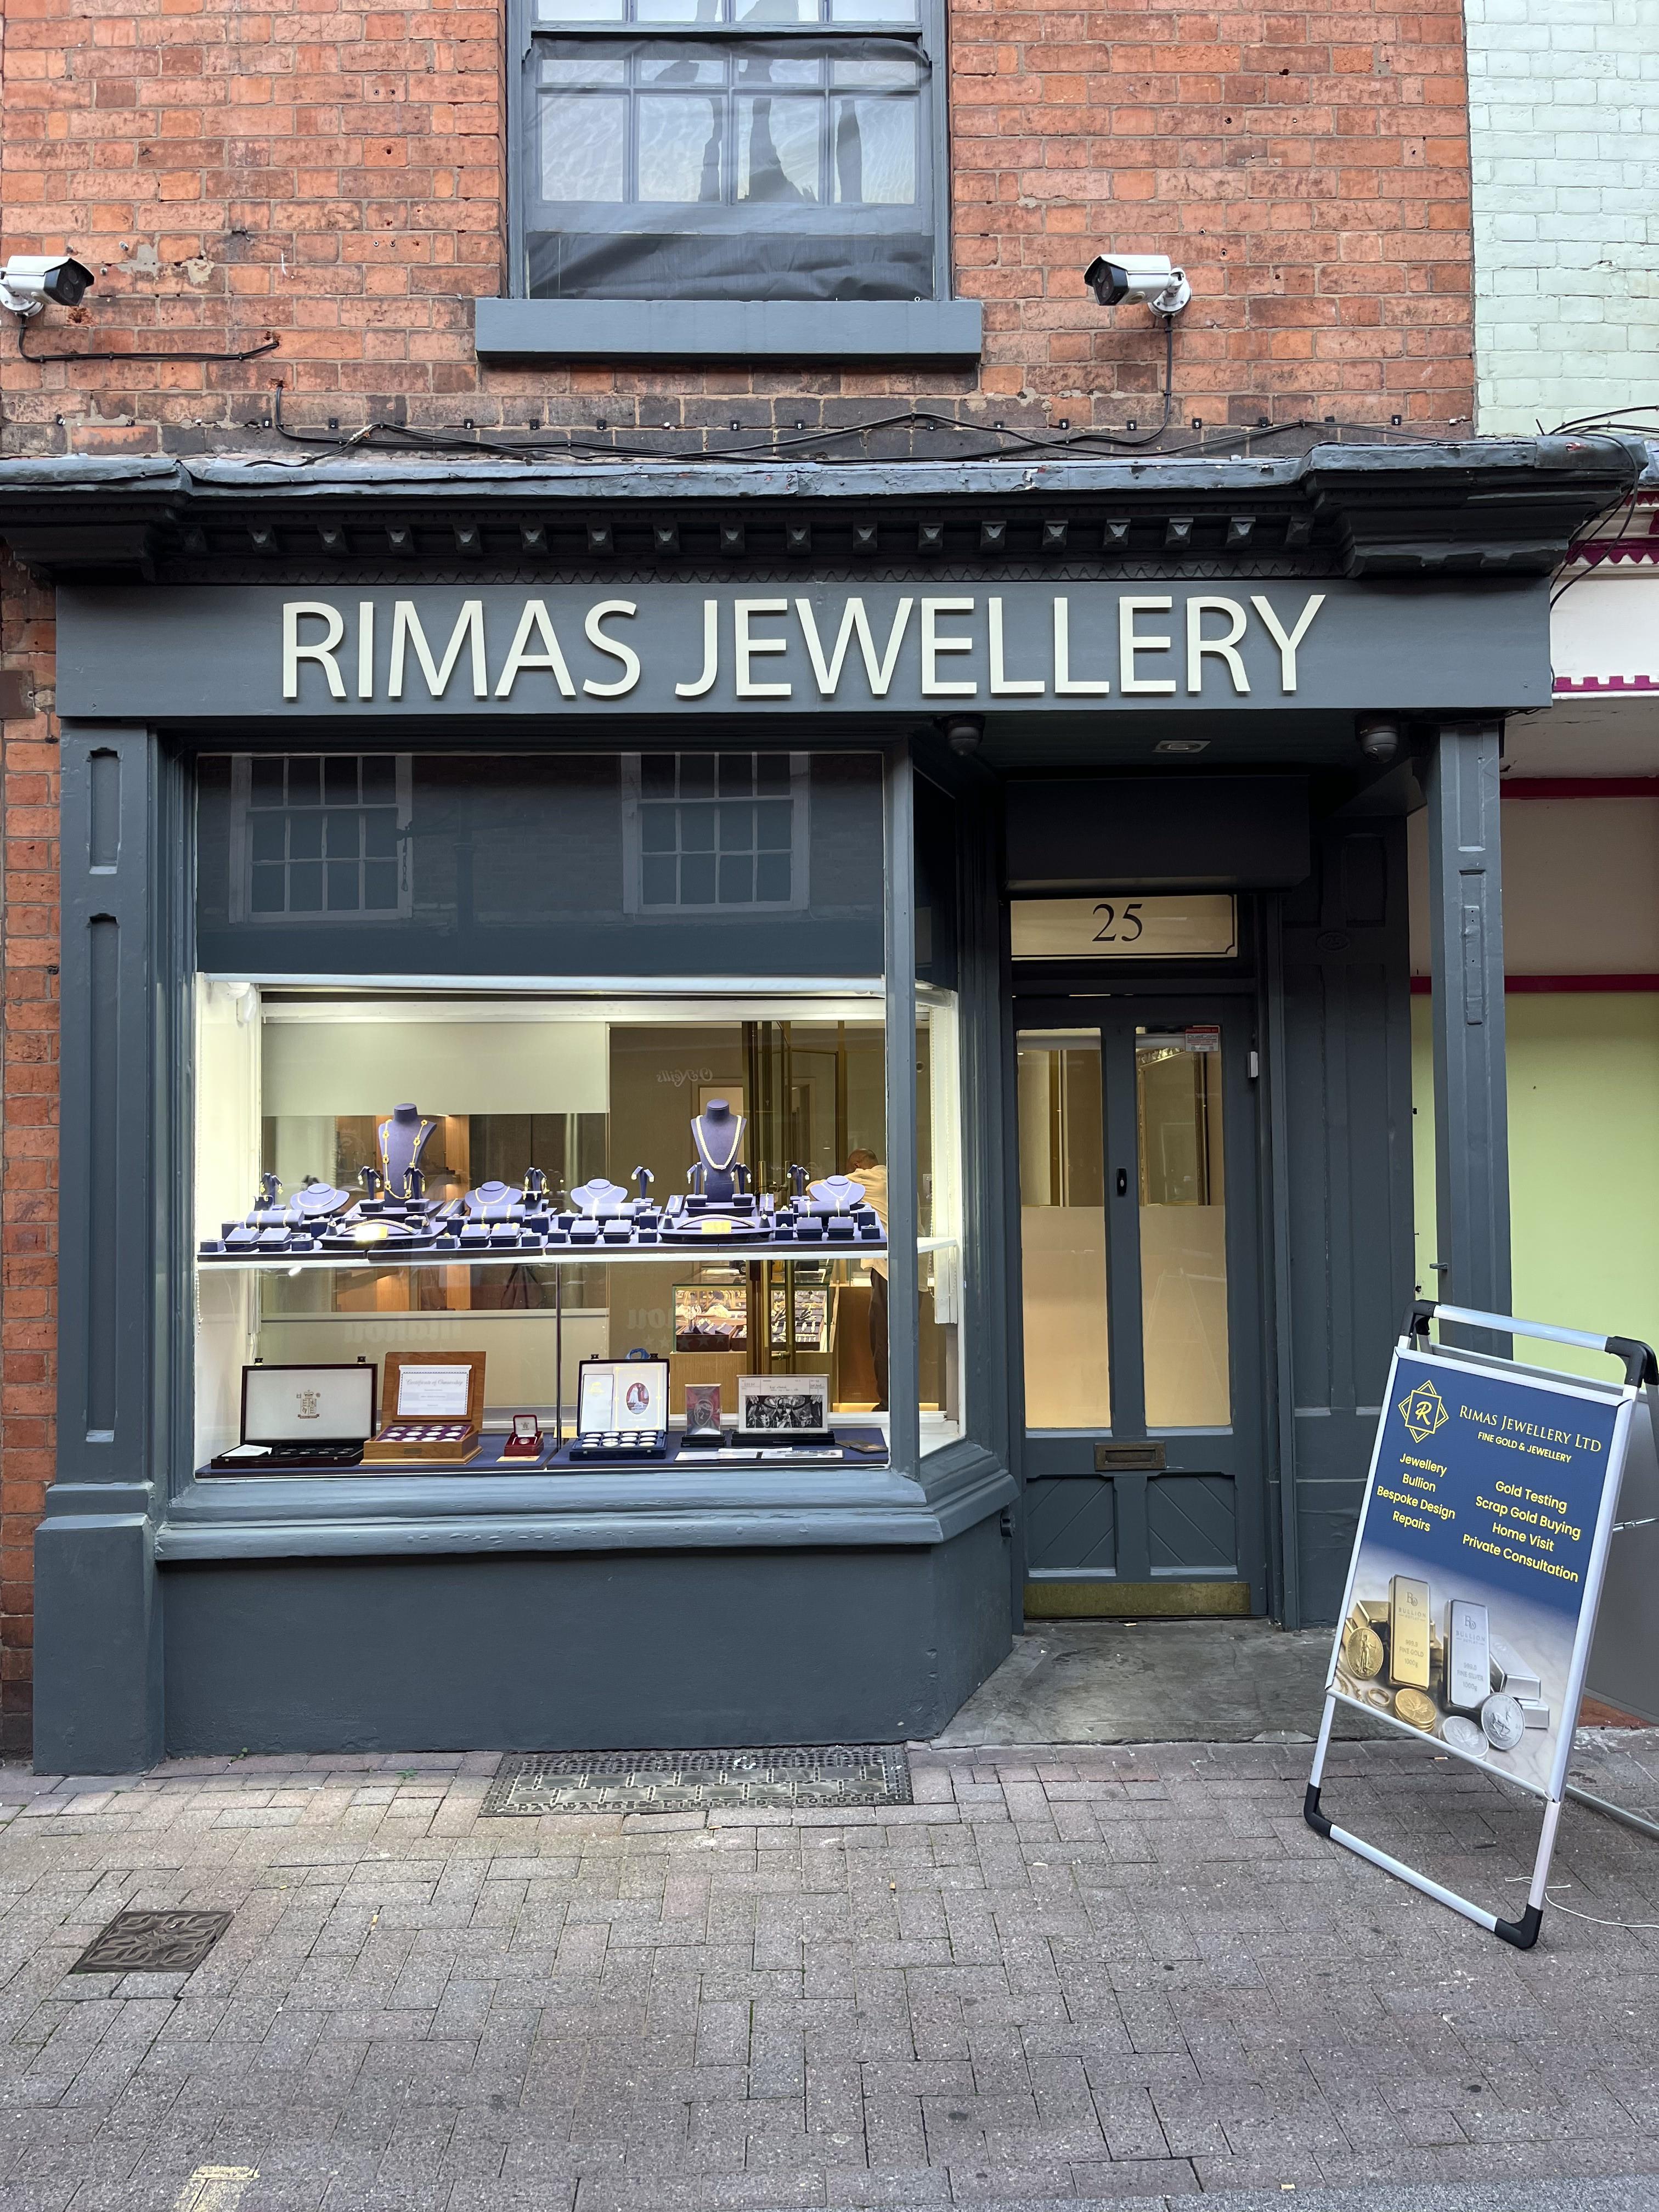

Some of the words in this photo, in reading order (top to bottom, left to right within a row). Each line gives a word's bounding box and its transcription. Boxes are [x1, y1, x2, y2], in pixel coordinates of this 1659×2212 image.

[283, 599, 641, 698] RIMAS
[675, 594, 1326, 697] JEWELLERY
[1092, 903, 1143, 942] 25
[1415, 1401, 1432, 1425] R
[1477, 1431, 1494, 1443] FINE
[1495, 1436, 1517, 1449] GOLD
[1518, 1442, 1526, 1452] &
[1526, 1444, 1572, 1463] JEWELLERY
[1400, 1453, 1447, 1477] Jewellery
[1402, 1473, 1436, 1493] Bullion
[1376, 1485, 1419, 1507] Bespoke
[1420, 1499, 1456, 1520] Design
[1495, 1481, 1522, 1498] Gold
[1525, 1488, 1567, 1514] Testing
[1392, 1510, 1431, 1532] Repairs
[1475, 1496, 1508, 1517] Scrap
[1510, 1506, 1538, 1524] Gold
[1539, 1515, 1581, 1541] Buying
[1492, 1522, 1526, 1542] Home
[1530, 1533, 1555, 1552] Visit
[1462, 1533, 1501, 1556] Private
[1503, 1548, 1579, 1583] Consultation
[1398, 1607, 1426, 1618] BULLION
[1456, 1630, 1485, 1641] BULLION
[1400, 1646, 1409, 1655] FINE
[1410, 1649, 1424, 1657] GOLD
[1404, 1658, 1418, 1668] 1000g
[1457, 1669, 1467, 1678] FINE
[1468, 1672, 1483, 1681] SILVER
[1463, 1681, 1477, 1692] 1000g
[518, 1801, 634, 1812] HAYWARDS
[663, 1799, 766, 1809] LIMITED
[795, 1796, 875, 1805] LONDON
